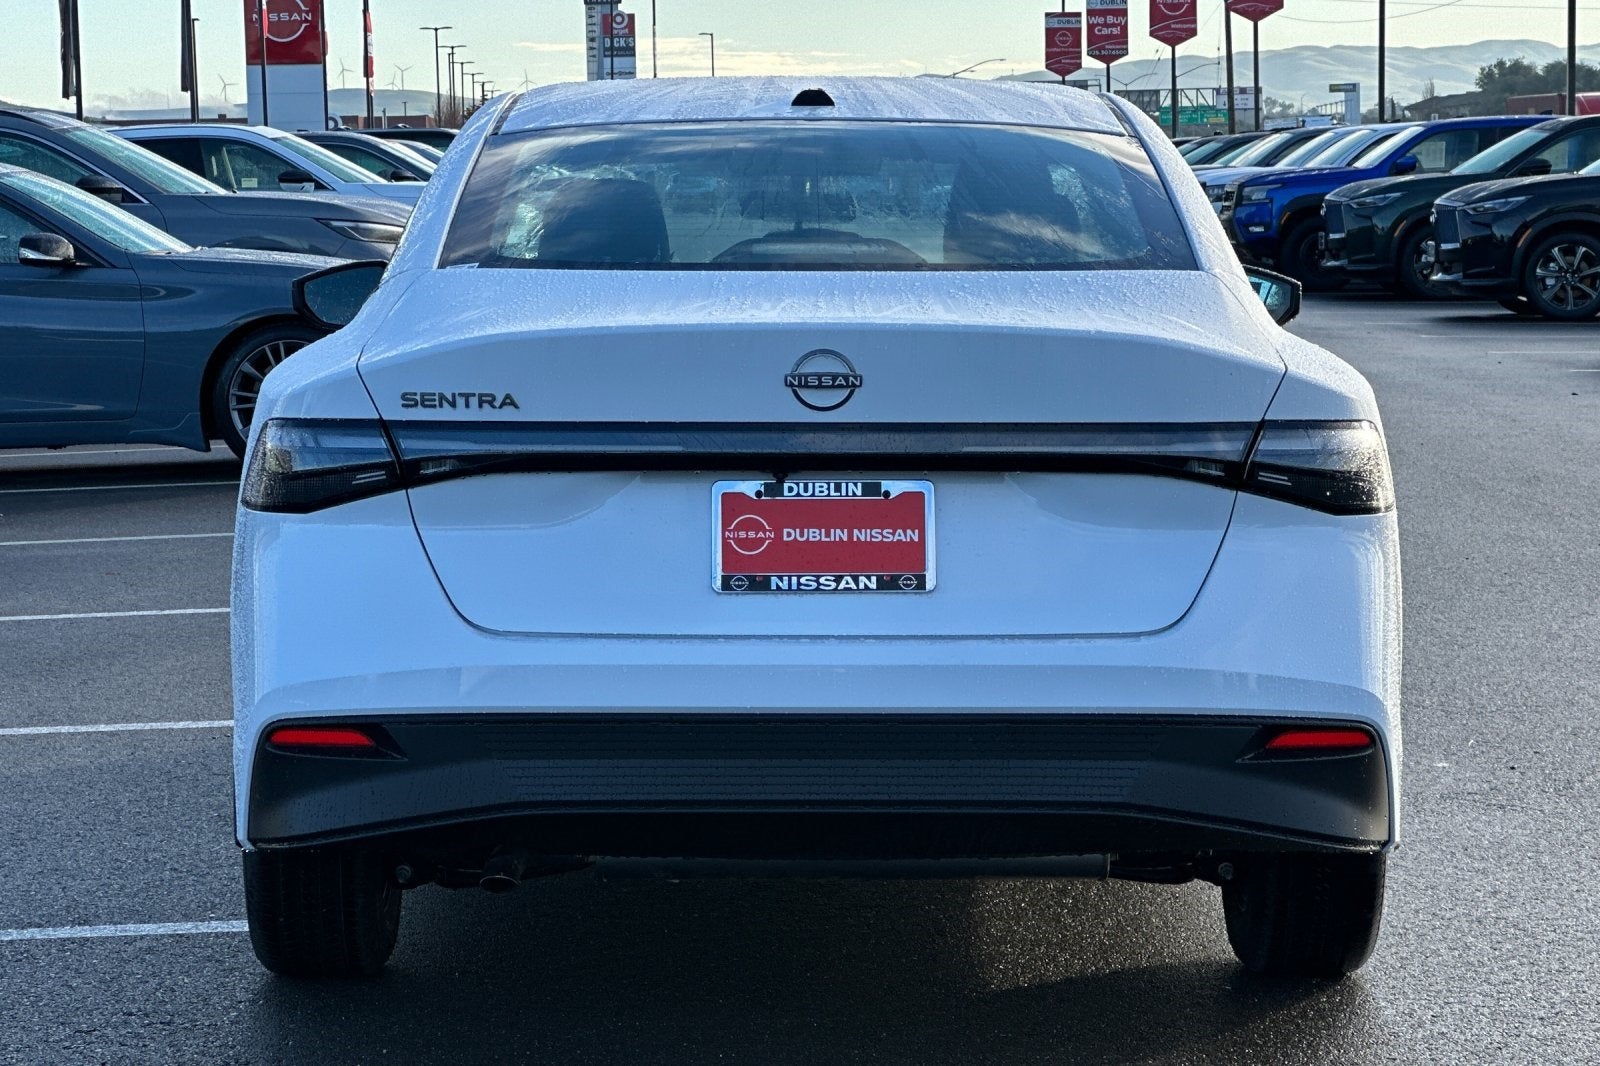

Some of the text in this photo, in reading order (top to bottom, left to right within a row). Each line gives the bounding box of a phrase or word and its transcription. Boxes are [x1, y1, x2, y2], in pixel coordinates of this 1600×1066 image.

[252, 13, 311, 21] NSSAN
[1088, 16, 1126, 25] We Buy
[604, 38, 634, 47] DCK'S
[787, 376, 860, 386] NISSAN
[400, 391, 520, 409] SENTRA
[783, 481, 863, 497] DUBLIN
[783, 528, 920, 542] DUBLIN NISSAN
[770, 575, 878, 590] NISSAN
